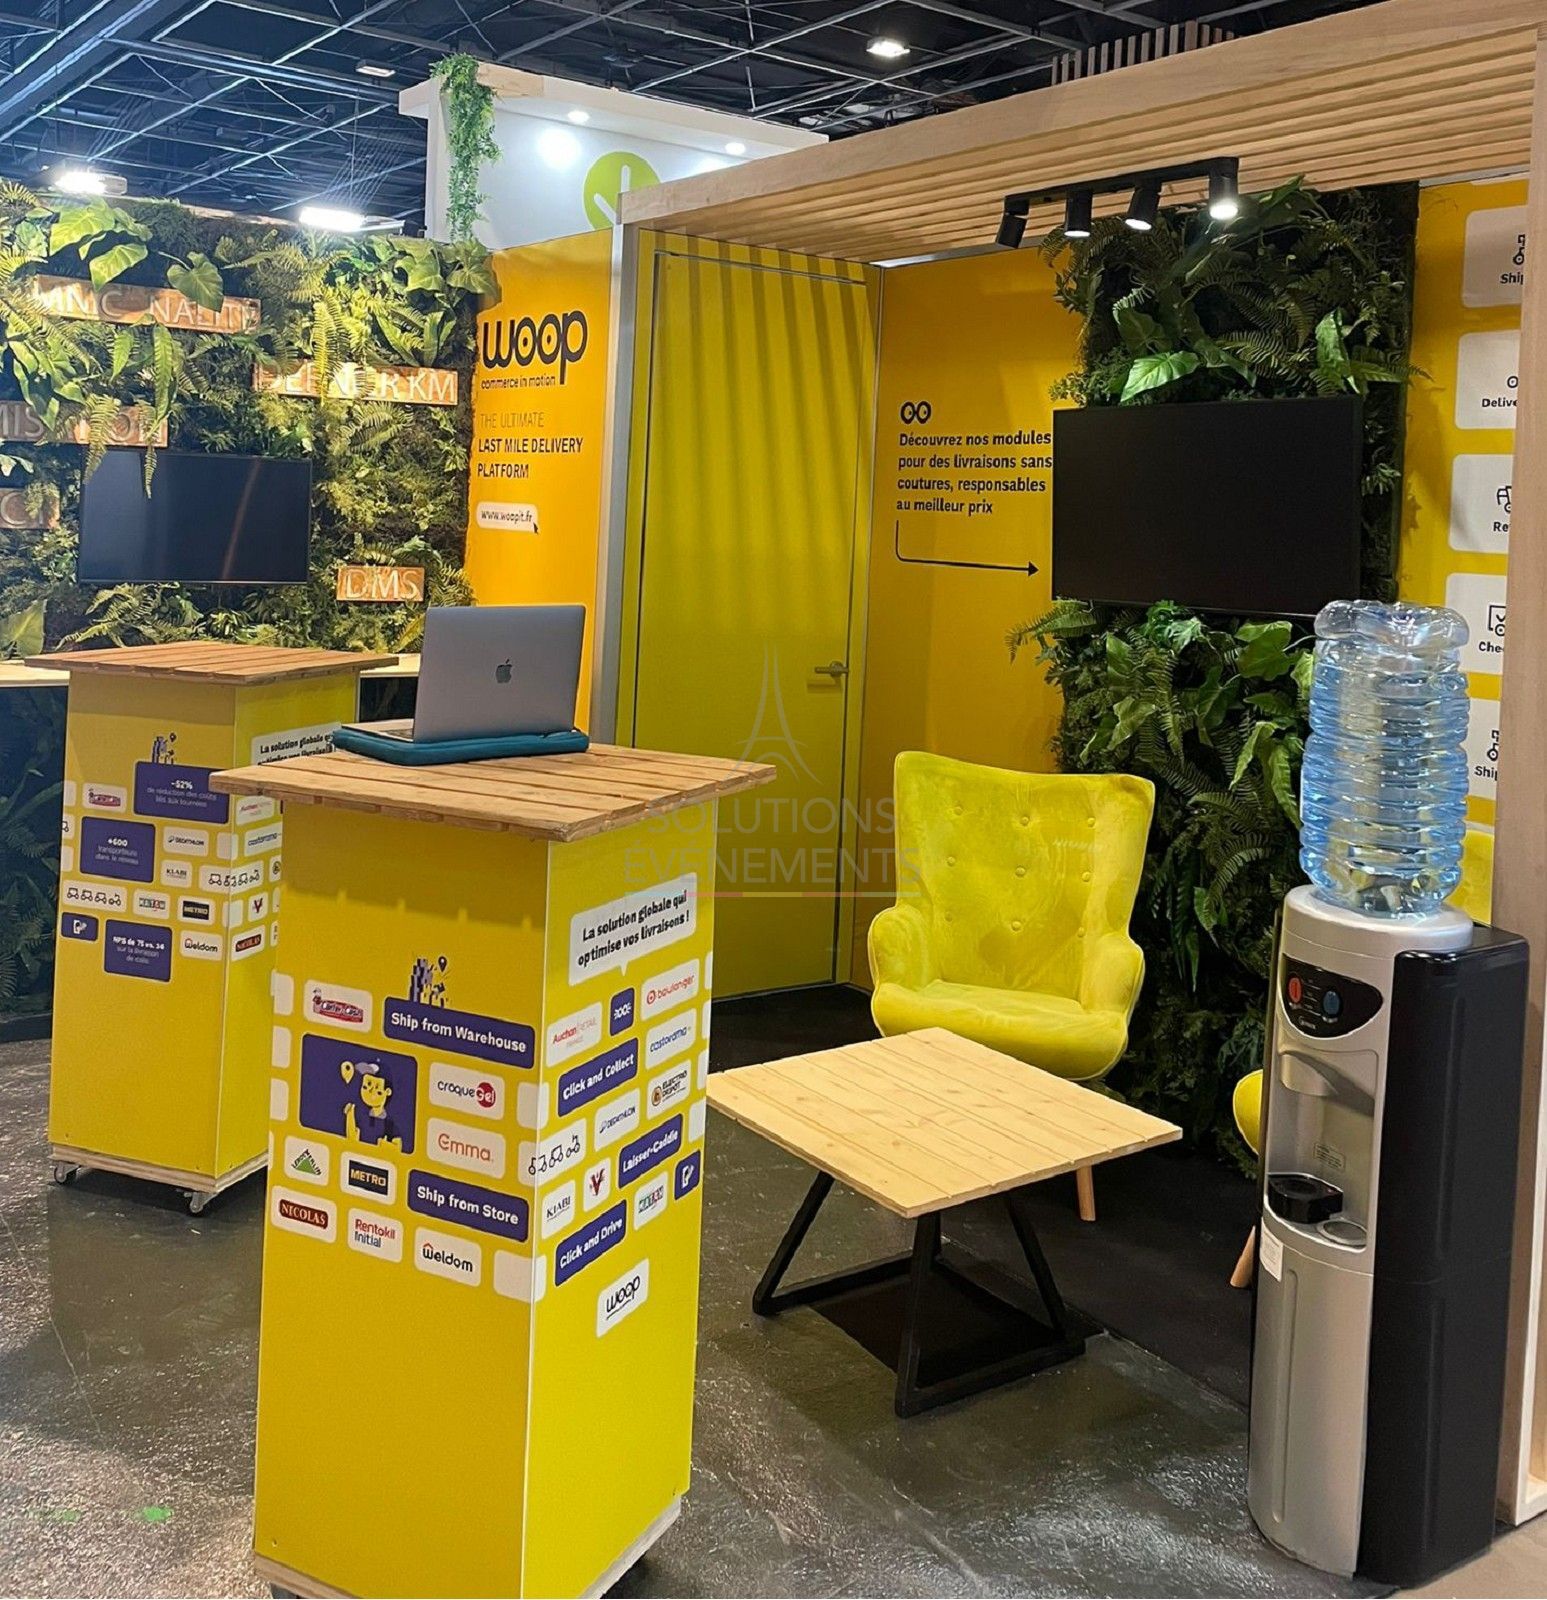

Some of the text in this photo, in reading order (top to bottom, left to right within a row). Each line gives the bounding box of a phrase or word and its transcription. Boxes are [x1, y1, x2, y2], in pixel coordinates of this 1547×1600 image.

[482, 310, 588, 385] woop
[406, 371, 455, 401] KM
[481, 375, 556, 389] commerce in motion
[480, 412, 545, 428] THE ULTIMATE
[478, 437, 584, 453] LAST MILE DELIVERY
[899, 430, 1052, 446] Découvrez nos modules
[477, 463, 529, 479] PLATFORM
[898, 454, 1053, 471] pour des livraisons sans
[897, 476, 1046, 494] coutures, responsables
[896, 497, 993, 516] au meilleur prix
[346, 569, 418, 599] DMS
[1478, 641, 1505, 654] Che
[259, 745, 269, 754] La
[270, 739, 299, 753] solution
[299, 734, 323, 748] globale
[582, 889, 688, 942] La solution globale qui
[578, 940, 621, 968] optimise
[623, 932, 639, 948] vos
[641, 914, 685, 940] livraisons
[657, 975, 695, 999] boulanger
[391, 1013, 527, 1053] Ship from Warehouse
[552, 1027, 577, 1044] Auchan
[649, 1026, 687, 1052] castorama
[563, 1053, 634, 1101] Click and Collect
[662, 1070, 688, 1090] ELECTRO
[622, 1129, 678, 1173] Laisser-Caddie
[350, 1168, 386, 1187] METRO
[281, 1201, 326, 1226] NICOLAS
[417, 1185, 519, 1226] Ship from Store
[546, 1195, 571, 1218] KIABI
[354, 1230, 382, 1249] Initial
[355, 1218, 396, 1240] Rentokil
[559, 1218, 623, 1269] Click and Drive
[606, 1275, 641, 1313] woop
